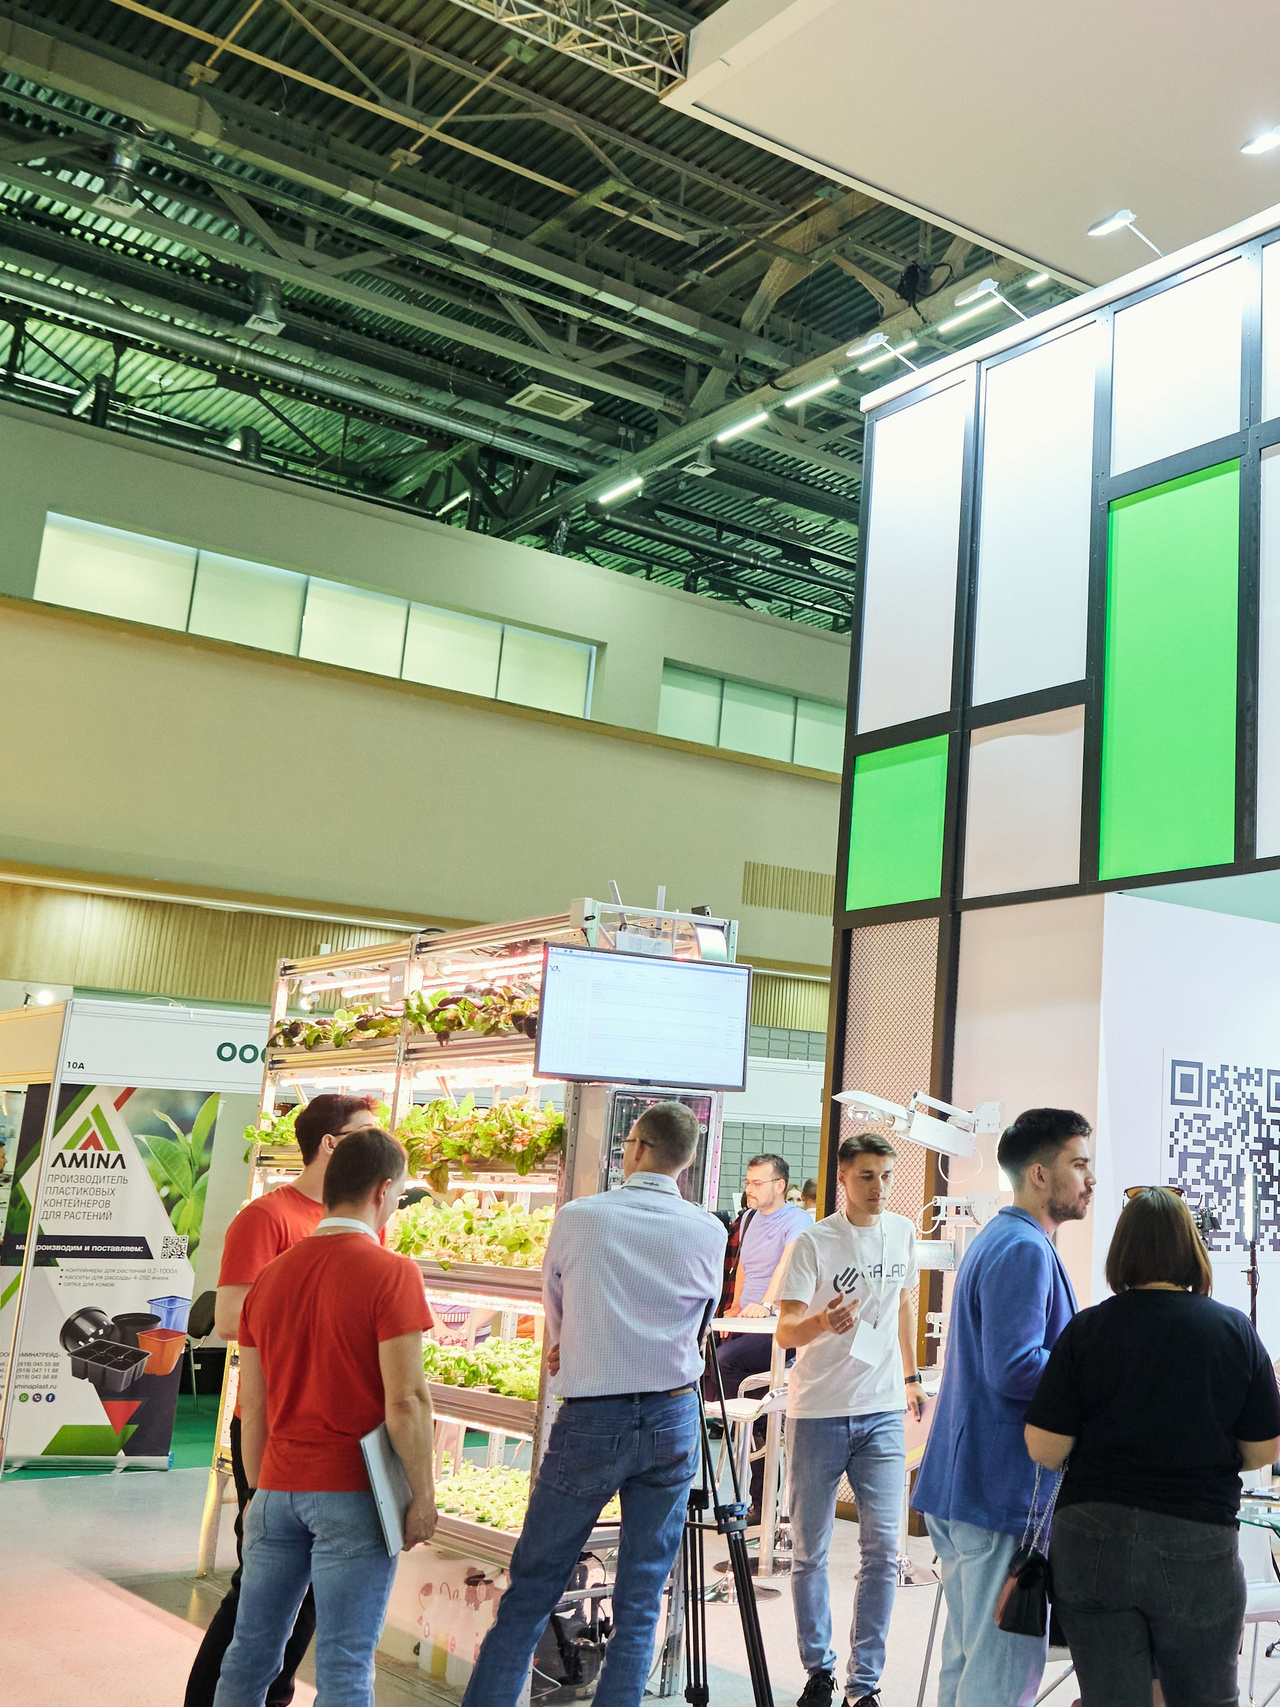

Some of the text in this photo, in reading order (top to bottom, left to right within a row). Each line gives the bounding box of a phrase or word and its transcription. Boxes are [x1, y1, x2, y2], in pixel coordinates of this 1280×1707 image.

[50, 1152, 127, 1170] AMINA
[46, 1174, 129, 1185] ПРОИЗВОДИТЕЛЬ
[44, 1186, 117, 1196] ПЛАСТИКОВЫХ
[43, 1197, 111, 1209] КОНТЕЙНЕРОВ
[41, 1210, 113, 1221] ДЛЯ РАСТЕНИЙ
[35, 1244, 83, 1253] роизводим
